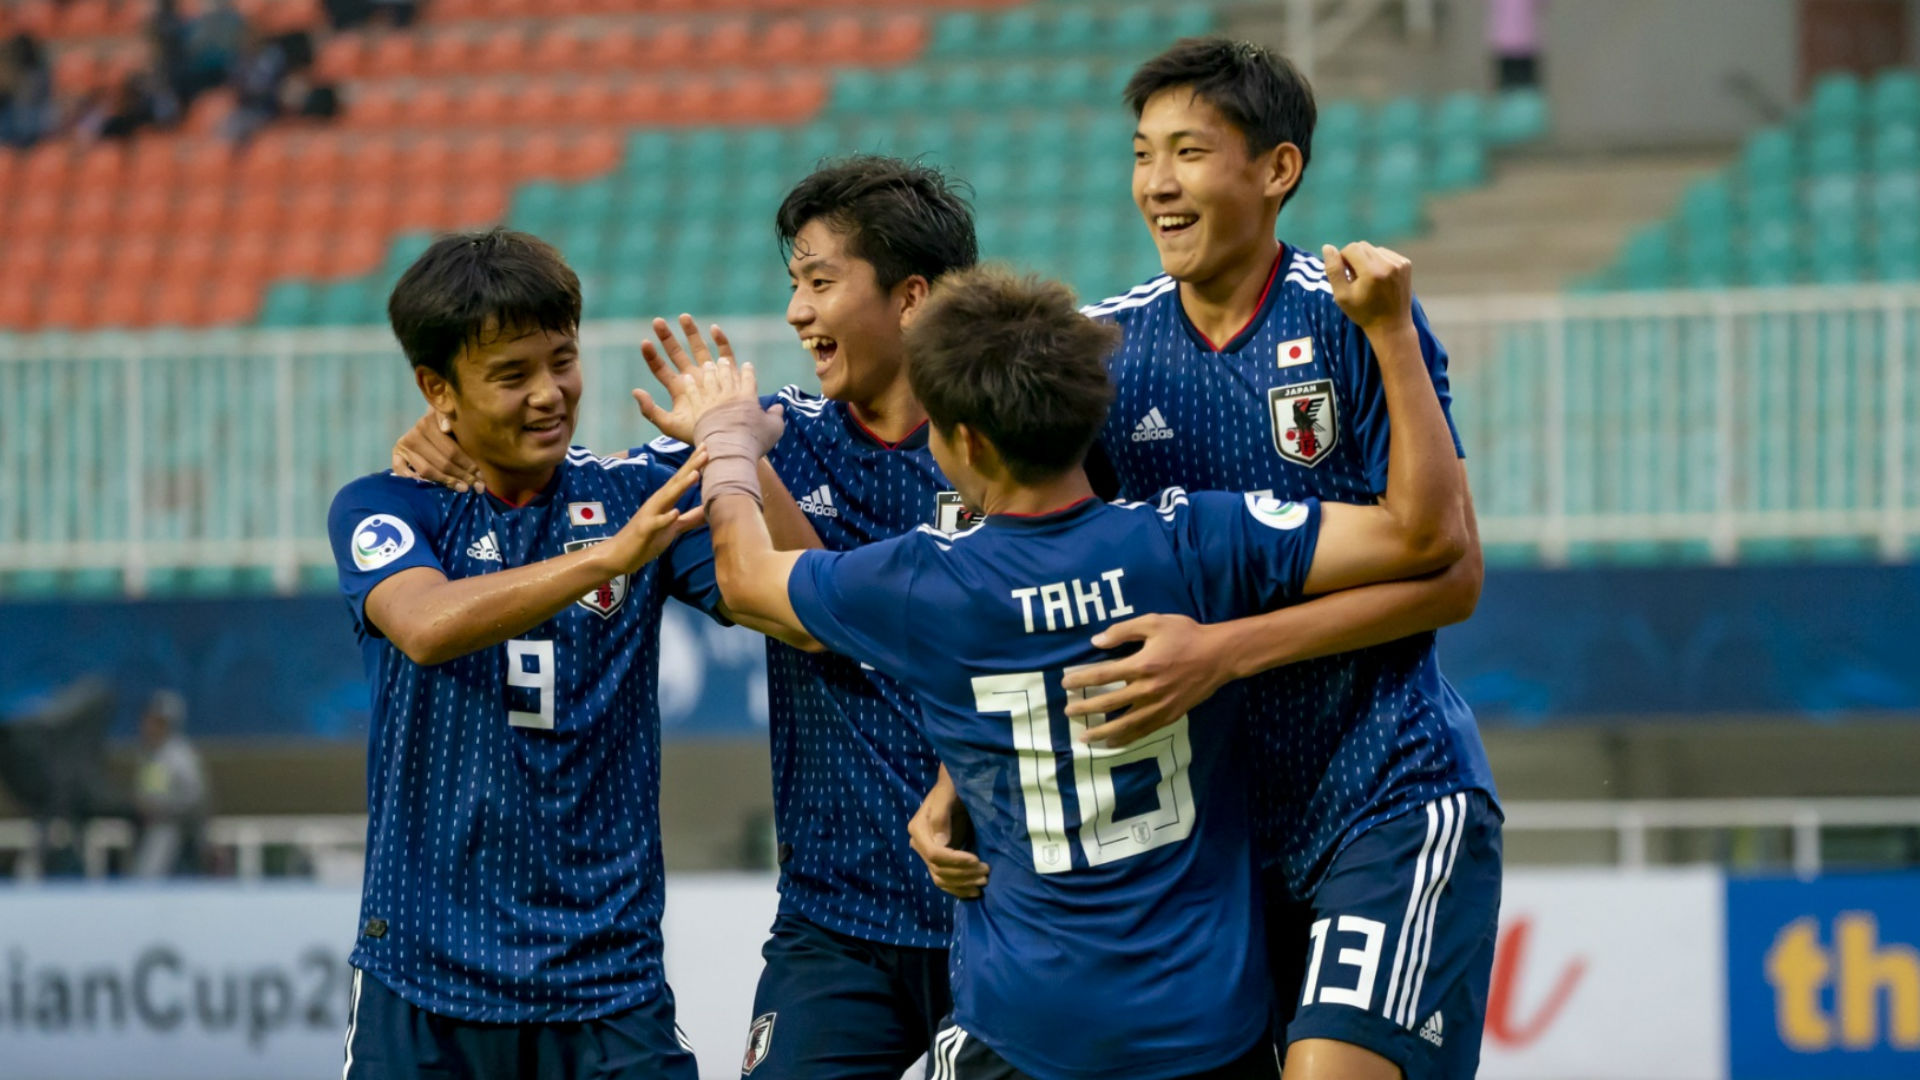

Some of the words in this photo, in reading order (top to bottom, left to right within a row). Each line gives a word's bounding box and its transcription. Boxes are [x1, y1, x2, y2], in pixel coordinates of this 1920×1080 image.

[1284, 384, 1317, 396] JAPAN
[1131, 428, 1174, 442] adidas
[1294, 438, 1323, 454] JFA
[1011, 568, 1134, 633] TAKI
[507, 639, 555, 730] 9
[970, 658, 1197, 875] 16
[1302, 915, 1386, 1011] 13
[1420, 1027, 1443, 1047] adidas
